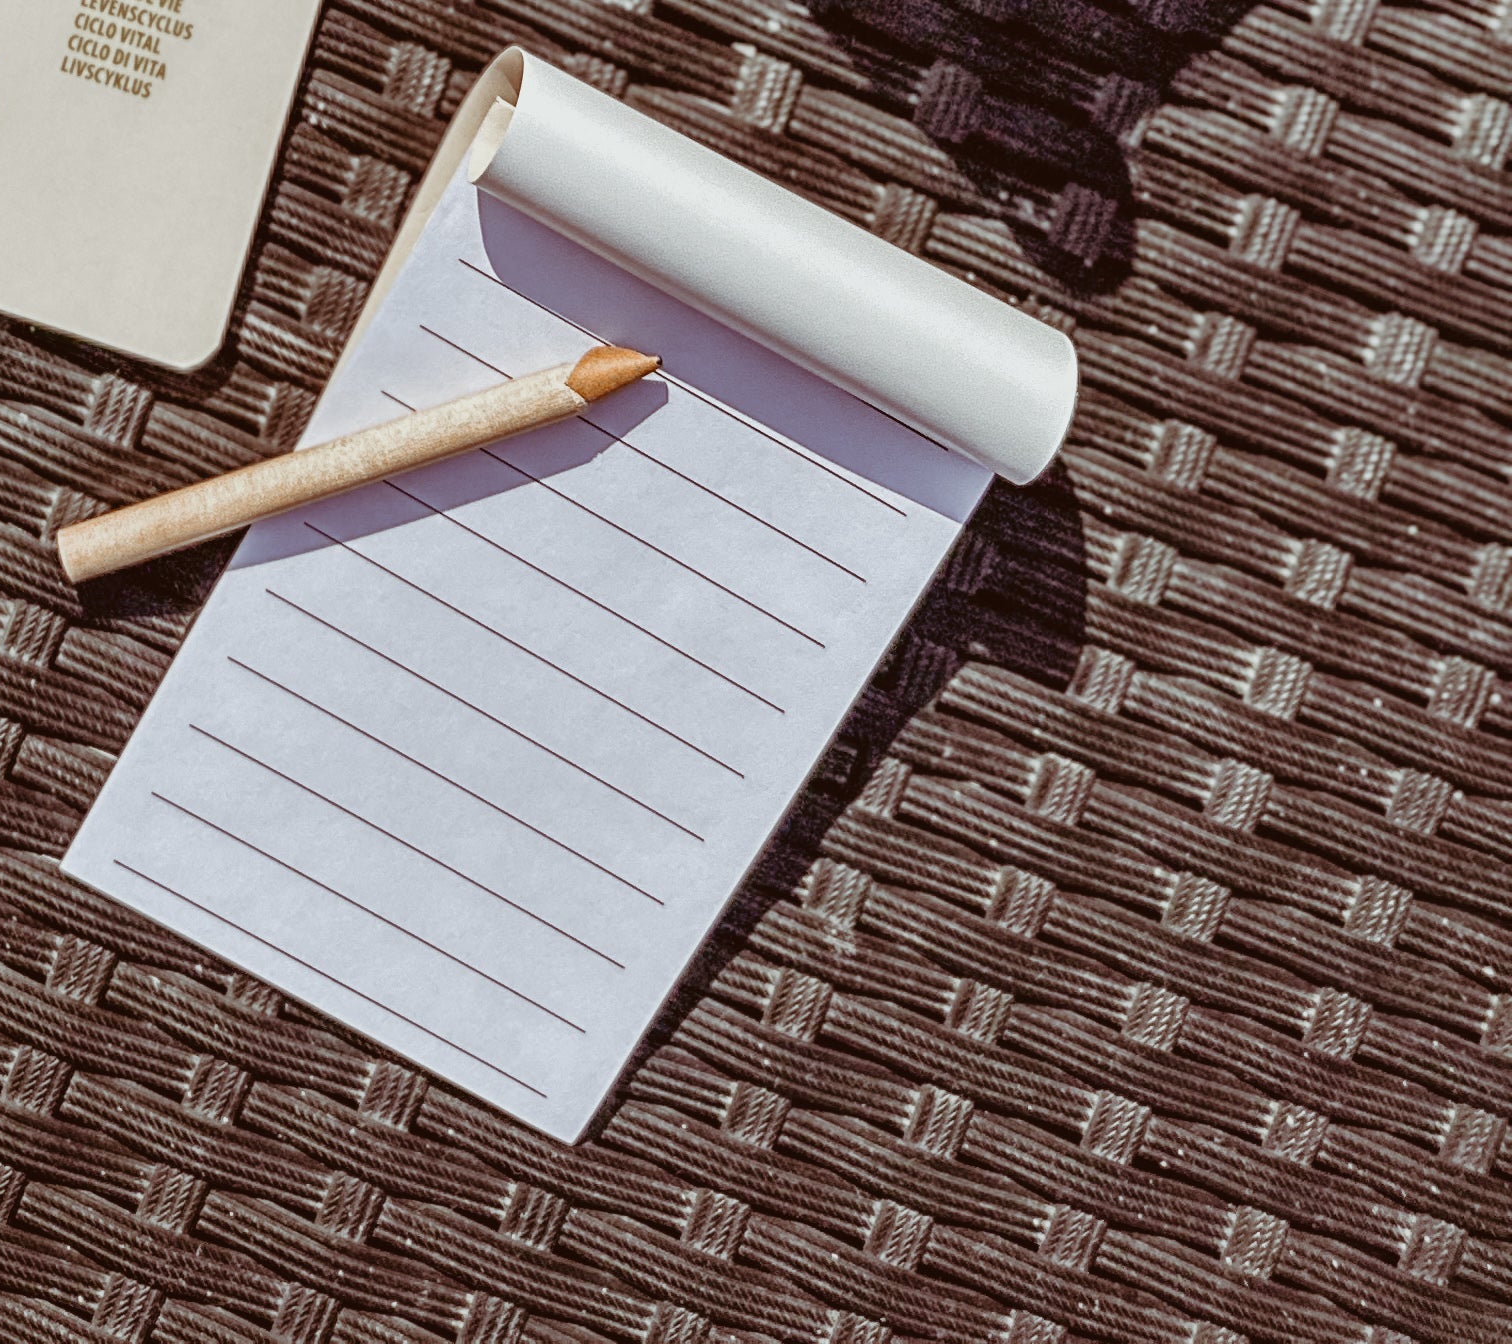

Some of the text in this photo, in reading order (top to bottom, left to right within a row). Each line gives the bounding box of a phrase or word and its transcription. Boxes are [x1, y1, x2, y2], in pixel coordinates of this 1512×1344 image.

[75, 13, 160, 54] CICLO VITAL
[61, 56, 152, 98] LIVSCYKLUS
[68, 34, 166, 80] CICLO DI VITA
